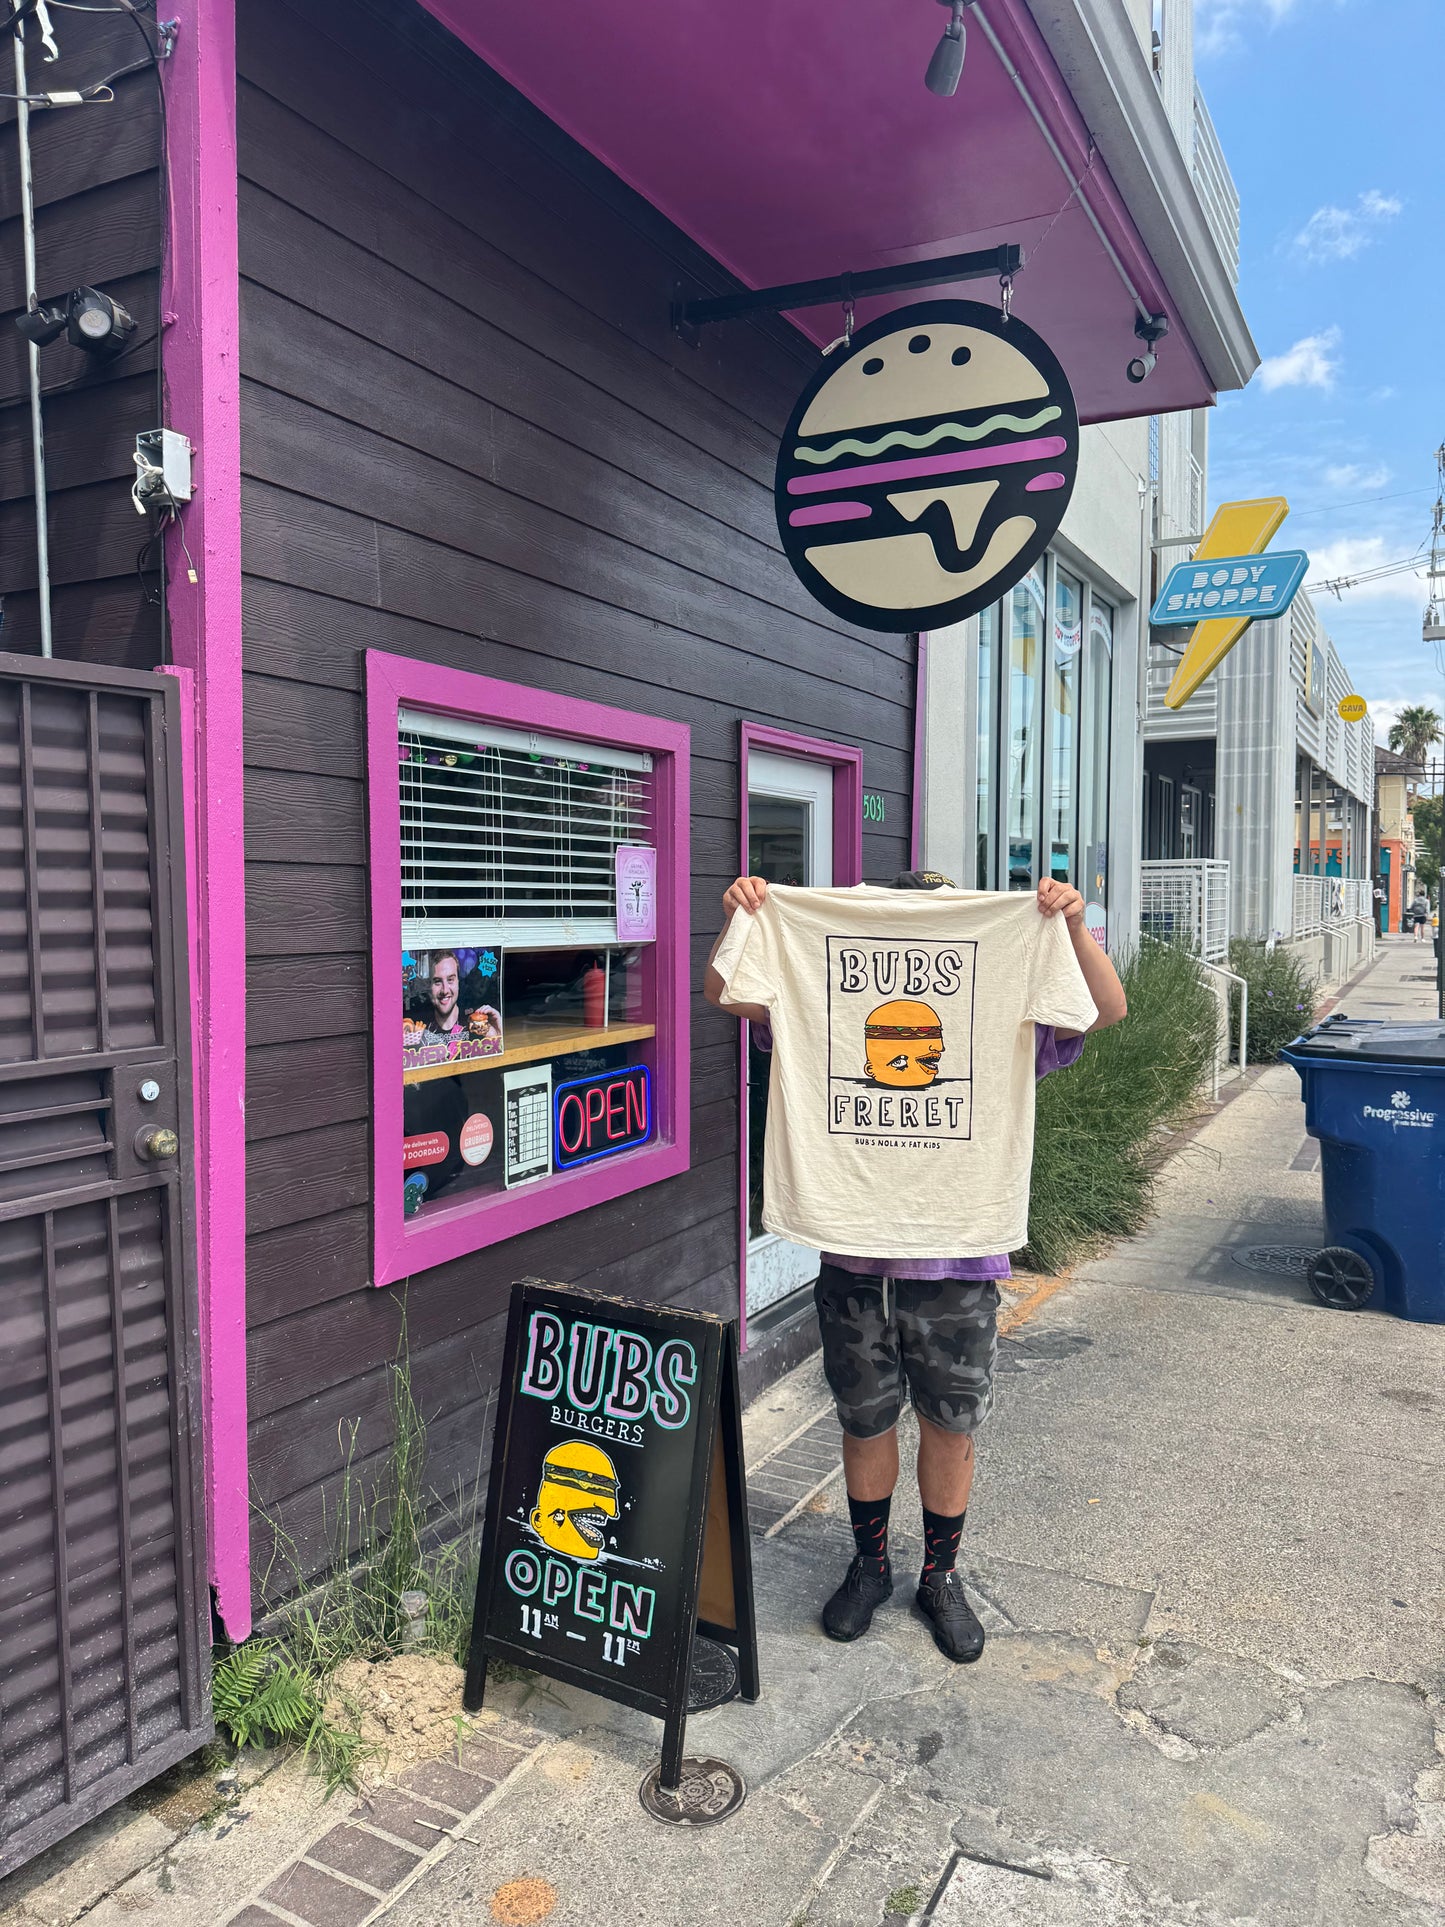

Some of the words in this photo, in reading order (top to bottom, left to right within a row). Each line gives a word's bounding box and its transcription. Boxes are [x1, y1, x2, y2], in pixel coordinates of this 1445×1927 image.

[1191, 565, 1268, 589] BODY
[1166, 584, 1277, 612] SHOPPE
[1341, 704, 1364, 713] CAVA
[863, 794, 885, 822] 5031
[839, 948, 964, 996] BUBS
[403, 1043, 448, 1068] OWER
[460, 1036, 502, 1060] PACK
[559, 1076, 647, 1153] OPEN
[834, 1094, 965, 1129] FRERET
[1363, 1105, 1435, 1122] Progressive
[407, 1146, 446, 1160] DOORDASH
[411, 1140, 428, 1148] deliver
[464, 1133, 490, 1148] GRUBHUB
[854, 1137, 876, 1146] BUB'S
[877, 1139, 899, 1148] NOLA
[908, 1141, 921, 1149] FAT
[520, 1310, 698, 1430] BUBS
[550, 1405, 645, 1444] BURGERS
[504, 1549, 657, 1640] OPEN
[708, 1776, 730, 1811] GAS
